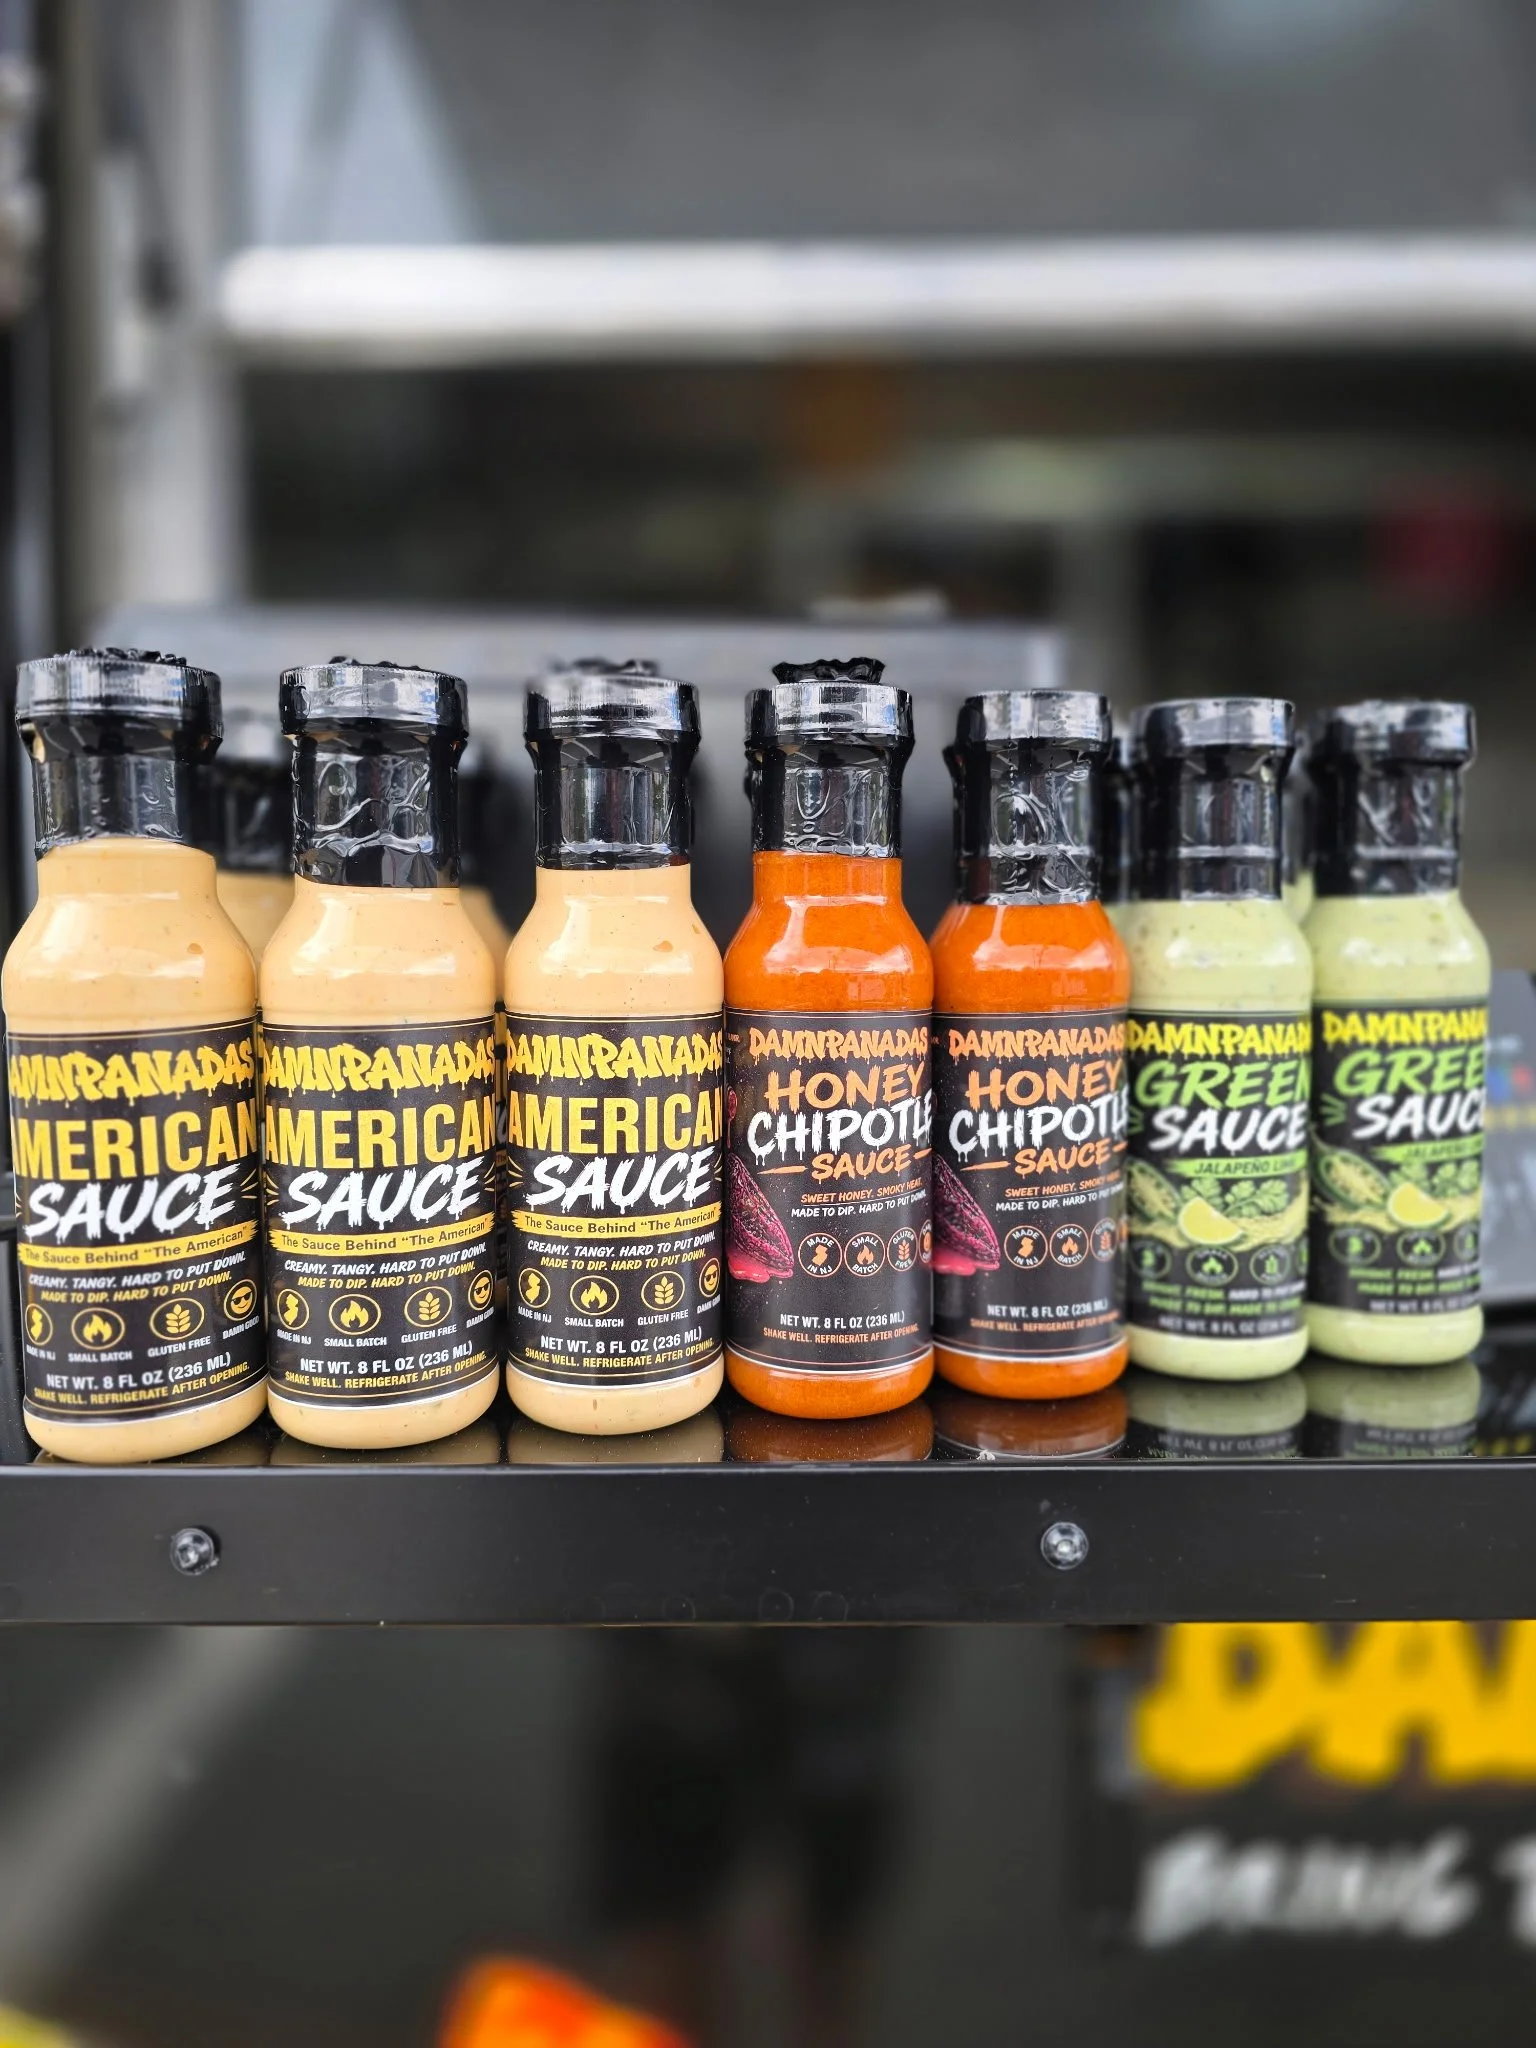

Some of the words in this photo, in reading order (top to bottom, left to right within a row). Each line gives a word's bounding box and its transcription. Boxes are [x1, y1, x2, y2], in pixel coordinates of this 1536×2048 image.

[1126, 1019, 1311, 1060] DAMNPANAD
[11, 1038, 255, 1107] AMNPANADAS
[1334, 1043, 1486, 1097] GREE
[764, 1061, 925, 1114] HONEY
[965, 1058, 1124, 1112] HONEY
[1135, 1058, 1311, 1110] GREEN
[508, 1086, 722, 1154] AMERICAN
[1352, 1086, 1486, 1141] SAUC
[265, 1092, 495, 1169] AMERICAN
[1149, 1102, 1307, 1156] SAUCE
[11, 1099, 257, 1181] MERICAN
[811, 1144, 912, 1185] SAUCE
[1015, 1138, 1111, 1179] SAUCE
[523, 1146, 714, 1214] SAUCE
[1005, 1186, 1039, 1198] SWEET
[1042, 1183, 1076, 1195] HONEY.
[23, 1163, 241, 1243] SAUCE
[278, 1156, 485, 1231] SAUCE
[801, 1194, 836, 1204] SWEET
[838, 1189, 874, 1201] HONEY.
[877, 1183, 905, 1197] SMOKY
[996, 1203, 1024, 1212] MADE
[1027, 1201, 1040, 1210] TO
[1042, 1199, 1060, 1209] DIP.
[1063, 1195, 1086, 1206] HARD
[1088, 1193, 1097, 1201] TO
[791, 1208, 820, 1217] MADE
[822, 1207, 835, 1217] TO
[838, 1206, 856, 1216] DIP.
[859, 1202, 883, 1213] HARD
[885, 1200, 895, 1209] TO
[898, 1196, 910, 1207] PUT
[525, 1216, 542, 1229] The
[546, 1221, 583, 1233] Sauce
[588, 1222, 636, 1233] Behind
[1012, 1228, 1039, 1240] MADE
[1057, 1227, 1083, 1239] SMALL
[281, 1234, 298, 1248] The
[302, 1238, 340, 1250] Sauce
[345, 1238, 397, 1251] Behind
[527, 1240, 570, 1256] CREAMY.
[574, 1246, 615, 1258] TANGY.
[619, 1243, 654, 1257] HARD
[657, 1241, 671, 1253] TO
[673, 1239, 693, 1251] PUT
[806, 1236, 835, 1248] MADE
[851, 1235, 879, 1248] SMALL
[25, 1249, 41, 1262] The
[43, 1252, 80, 1264] Sauce
[85, 1251, 139, 1264] Behind
[285, 1260, 328, 1275] CREAMY.
[332, 1264, 375, 1275] TANGY.
[380, 1261, 416, 1274] HARD
[420, 1257, 435, 1269] TO
[438, 1252, 460, 1266] PUT
[541, 1257, 568, 1269] MADE
[571, 1260, 585, 1270] TO
[587, 1260, 608, 1271] DIP.
[611, 1259, 642, 1271] HARD
[645, 1257, 659, 1268] TO
[661, 1254, 680, 1266] PUT
[682, 1248, 707, 1262] DOWN.
[1013, 1256, 1024, 1265] IN
[1026, 1257, 1039, 1266] NJ
[1057, 1253, 1083, 1265] BATCH
[298, 1276, 326, 1288] MADE
[329, 1278, 342, 1289] TO
[346, 1279, 368, 1289] DIP.
[371, 1276, 404, 1288] HARD
[407, 1274, 422, 1286] TO
[425, 1269, 445, 1282] PUT
[807, 1264, 818, 1274] IN
[820, 1265, 832, 1275] NJ
[852, 1263, 879, 1274] BATCH
[638, 1314, 669, 1326] GLUTEN
[671, 1309, 689, 1321] FREE
[780, 1314, 799, 1327] NET
[802, 1317, 820, 1329] WT.
[824, 1318, 831, 1328] 8
[834, 1318, 847, 1329] FL
[849, 1317, 862, 1328] OZ
[866, 1313, 887, 1329] (236
[890, 1311, 905, 1323] ML)
[987, 1304, 1007, 1317] NET
[1009, 1306, 1029, 1318] WT.
[1031, 1306, 1038, 1317] 8
[1041, 1306, 1053, 1318] FL
[1056, 1305, 1069, 1317] OZ
[565, 1317, 593, 1327] SMALL
[595, 1319, 624, 1327] BATCH
[324, 1338, 354, 1347] SMALL
[356, 1337, 387, 1347] BATCH
[401, 1330, 435, 1343] GLUTEN
[438, 1324, 457, 1337] FREE
[541, 1335, 563, 1351] NET
[567, 1340, 592, 1353] WT.
[596, 1341, 605, 1353] 8
[610, 1341, 626, 1353] FL
[631, 1339, 649, 1353] OZ
[653, 1334, 680, 1351] (236
[684, 1326, 702, 1343] ML)
[763, 1327, 787, 1340] SHAKE
[788, 1331, 812, 1343] WELL.
[815, 1334, 868, 1344] REFRIGERATE
[870, 1330, 892, 1342] AFTER
[300, 1358, 324, 1373] NET
[327, 1361, 353, 1375] WT.
[358, 1361, 368, 1374] 8
[372, 1360, 391, 1374] FL
[394, 1356, 415, 1371] OZ
[419, 1349, 449, 1369] (236
[452, 1340, 473, 1359] ML)
[525, 1347, 549, 1362] SHAKE
[551, 1354, 579, 1367] WELL.
[583, 1354, 652, 1368] REFRIGERATE
[655, 1350, 683, 1364] AFTER
[46, 1374, 68, 1389] NET
[72, 1377, 98, 1390] WT.
[103, 1376, 114, 1389] 8
[119, 1374, 137, 1388] FL
[142, 1370, 164, 1385] OZ
[168, 1362, 202, 1382] (236
[207, 1352, 231, 1371] ML)
[285, 1371, 310, 1385] SHAKE
[312, 1376, 342, 1388] WELL.
[345, 1372, 419, 1389] REFRIGERATE
[421, 1365, 452, 1381] AFTER
